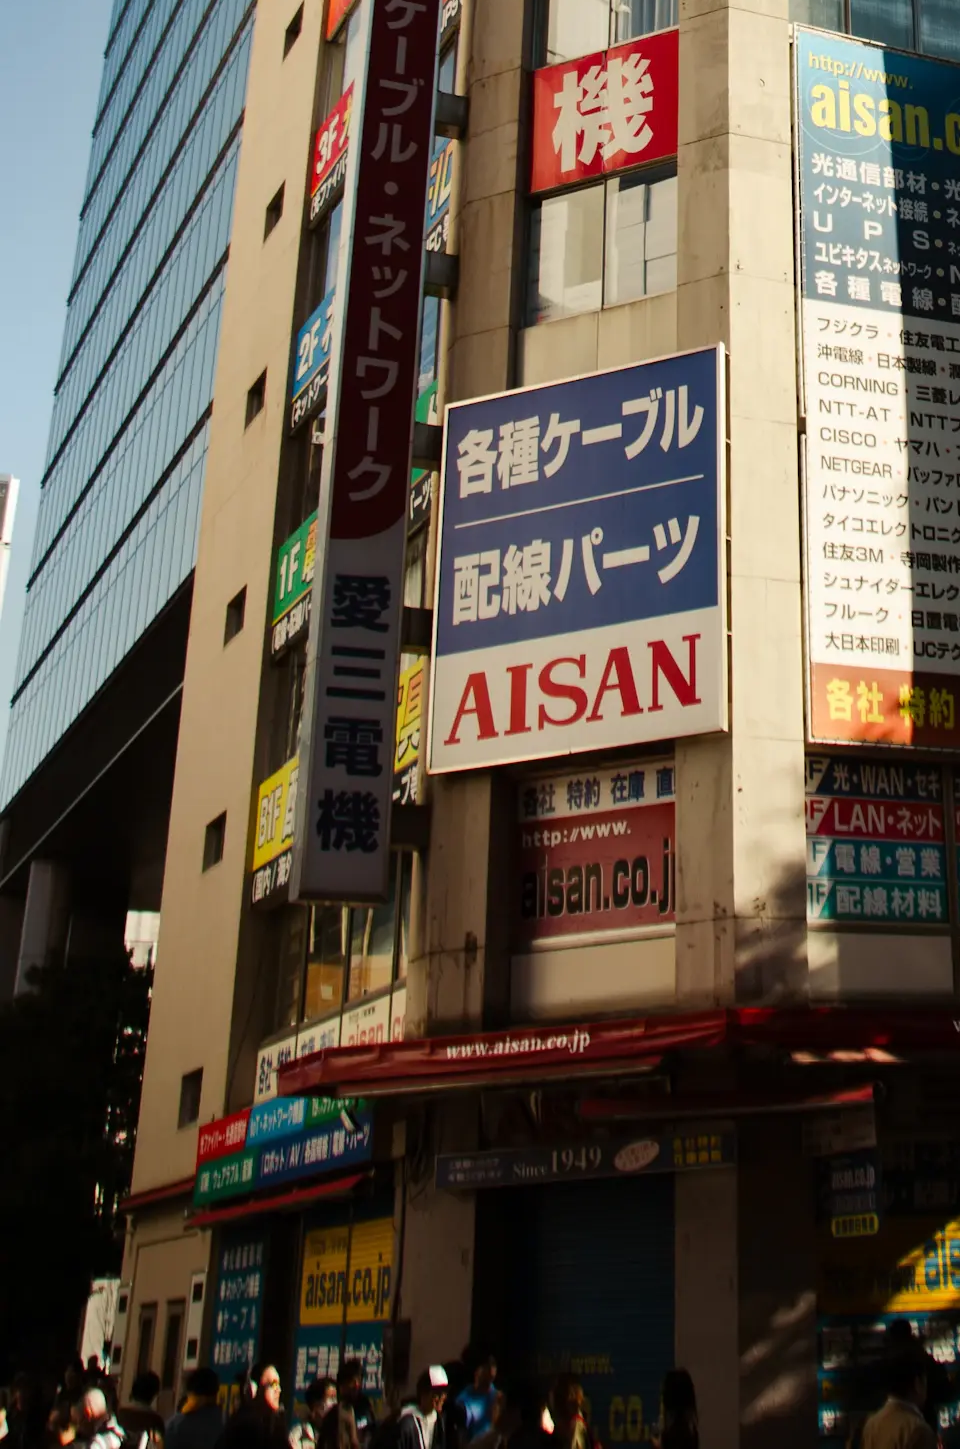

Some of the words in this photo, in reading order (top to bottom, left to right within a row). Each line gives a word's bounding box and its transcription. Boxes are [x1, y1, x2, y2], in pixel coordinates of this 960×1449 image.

[808, 51, 914, 90] http://www.
[456, 384, 705, 499] 各種ケーブル
[452, 515, 701, 627] 配線パーツ
[316, 573, 393, 854] 愛三電機
[444, 633, 702, 746] AISAN
[826, 678, 885, 724] 各社
[899, 684, 955, 729] 特約
[522, 820, 632, 848] http://www.
[522, 837, 676, 921] aisan.co.j
[446, 1029, 591, 1061] www.aisan.co.jp
